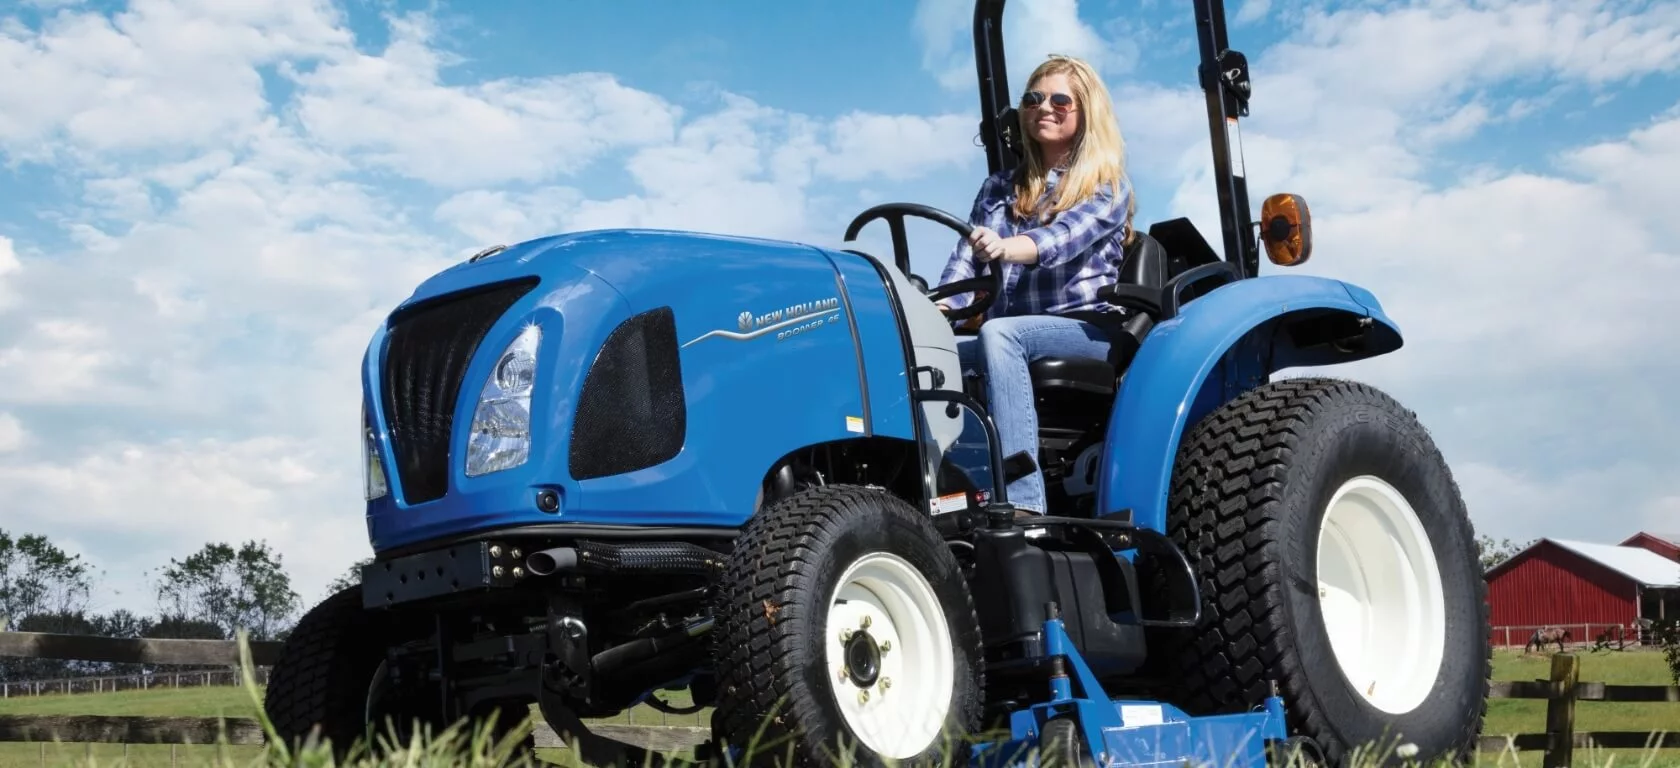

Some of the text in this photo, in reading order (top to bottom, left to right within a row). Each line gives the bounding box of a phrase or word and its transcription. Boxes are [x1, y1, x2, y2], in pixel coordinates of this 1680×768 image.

[756, 297, 838, 326] NEW HOLLAND
[777, 319, 823, 340] BOOMER
